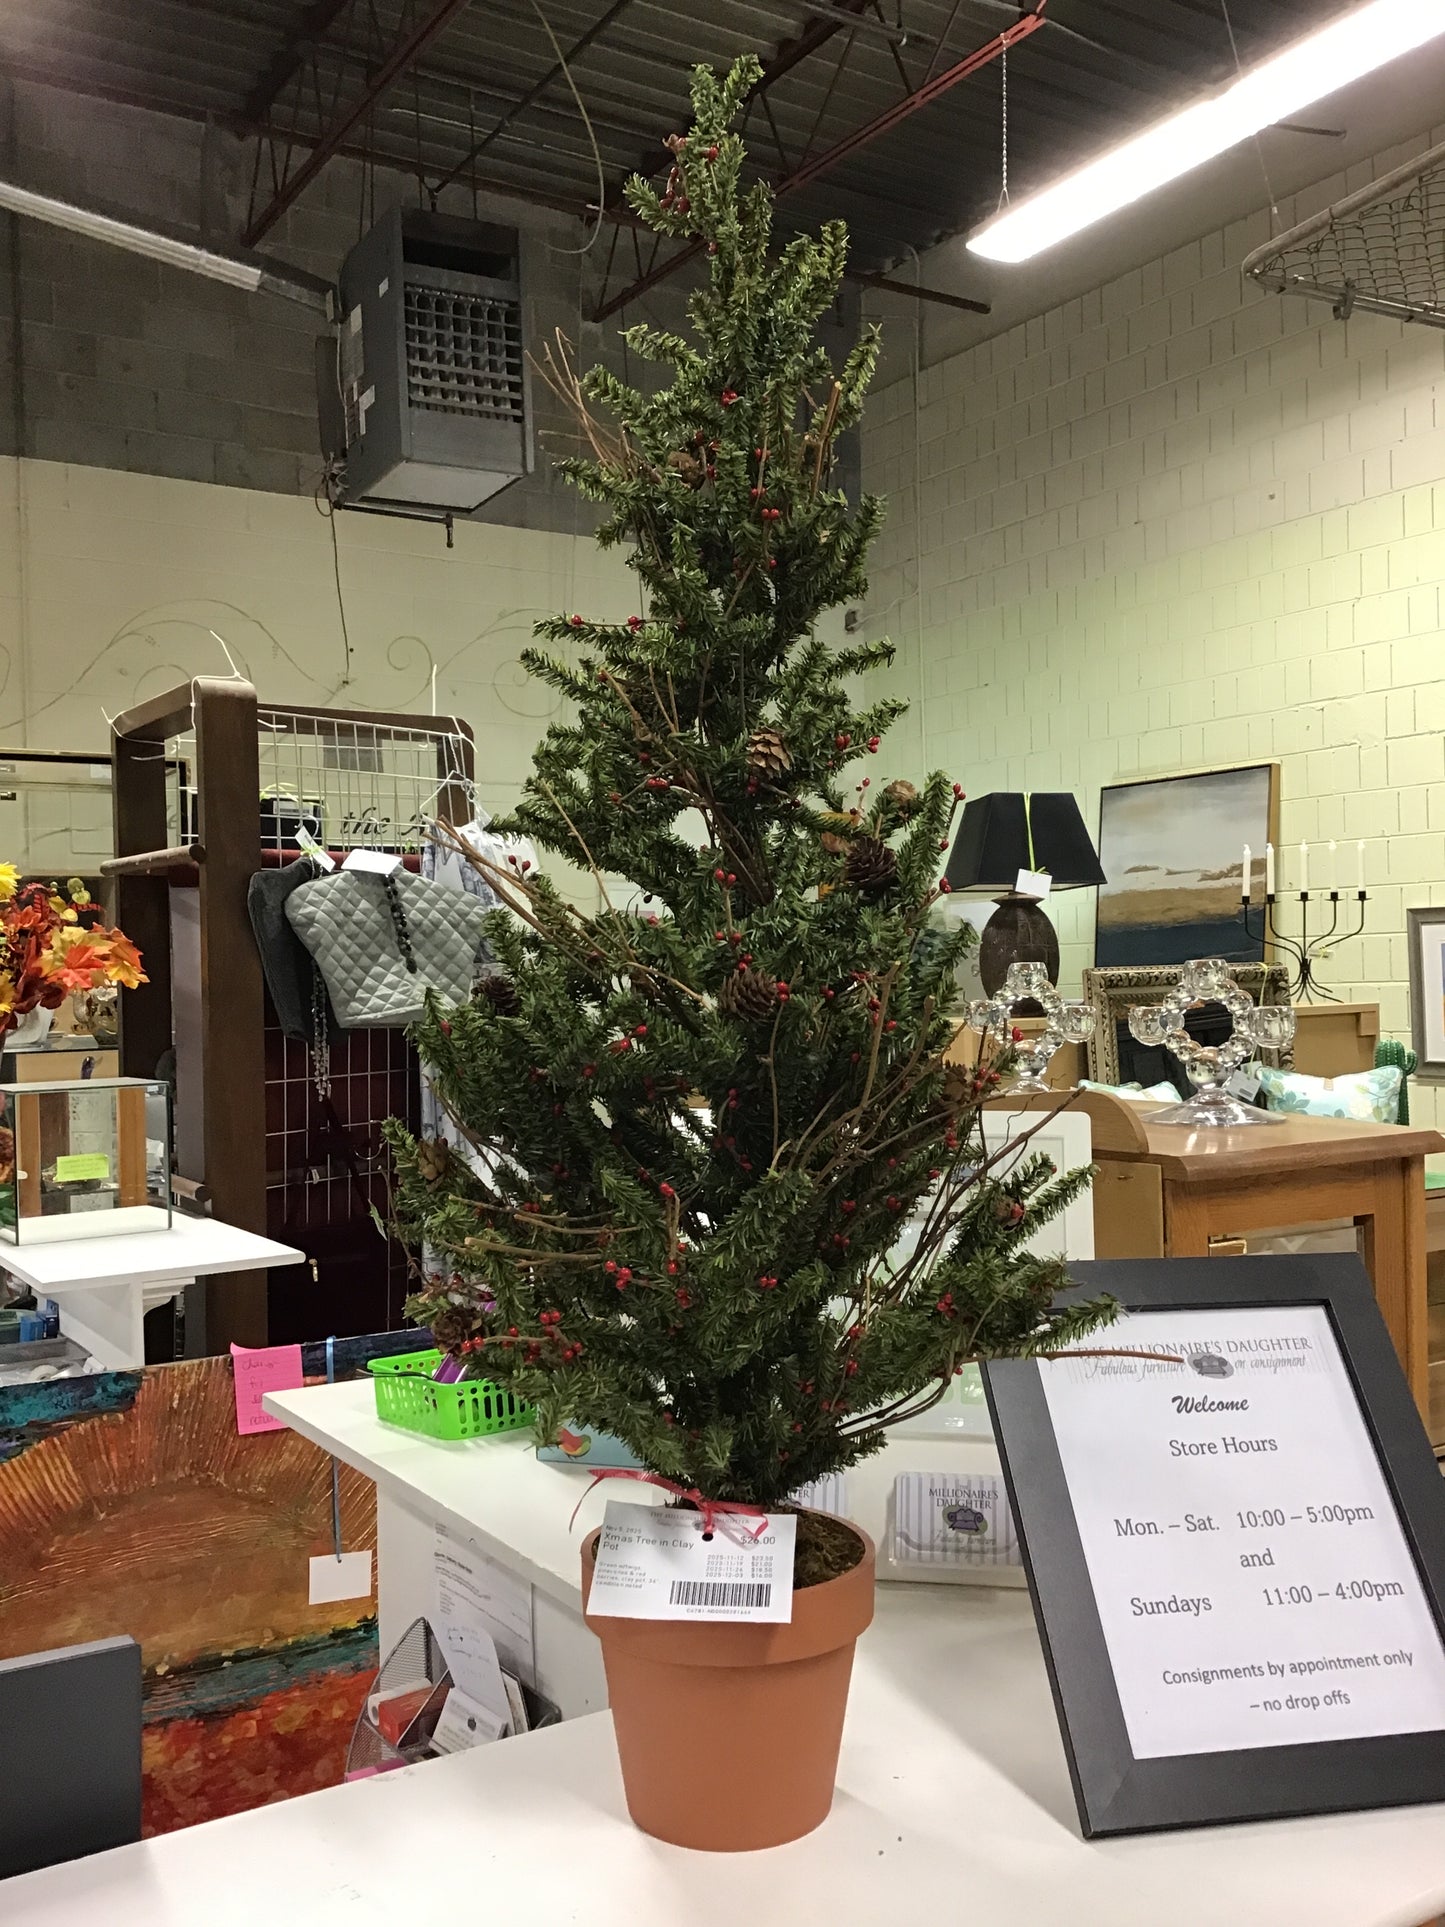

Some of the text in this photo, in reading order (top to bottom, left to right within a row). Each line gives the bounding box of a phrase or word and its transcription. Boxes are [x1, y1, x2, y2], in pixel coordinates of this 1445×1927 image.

[340, 807, 390, 836] the
[1226, 1337, 1313, 1353] DAUGHTER
[1250, 1354, 1307, 1374] consignment
[1171, 1394, 1250, 1414] Welcome
[1169, 1436, 1278, 1457] Store Hours
[936, 1497, 993, 1510] DAUGHTER
[1113, 1518, 1165, 1537] Mon.
[1184, 1513, 1220, 1533] Sat.
[1236, 1508, 1286, 1529] 10:00
[1306, 1504, 1375, 1526] 5:00pm
[603, 1532, 695, 1550] Xmas Tree in Clay
[603, 1541, 619, 1551] Pot
[740, 1535, 776, 1546] $26.00
[1239, 1547, 1275, 1568] and
[1130, 1594, 1213, 1617] Sundays
[1262, 1585, 1313, 1606] 11:00
[1335, 1579, 1405, 1602] 4:00pm
[1162, 1649, 1413, 1685] Consignments by appointment only
[1263, 1699, 1282, 1711] no
[1285, 1694, 1320, 1710] drop
[1323, 1689, 1351, 1706] offs
